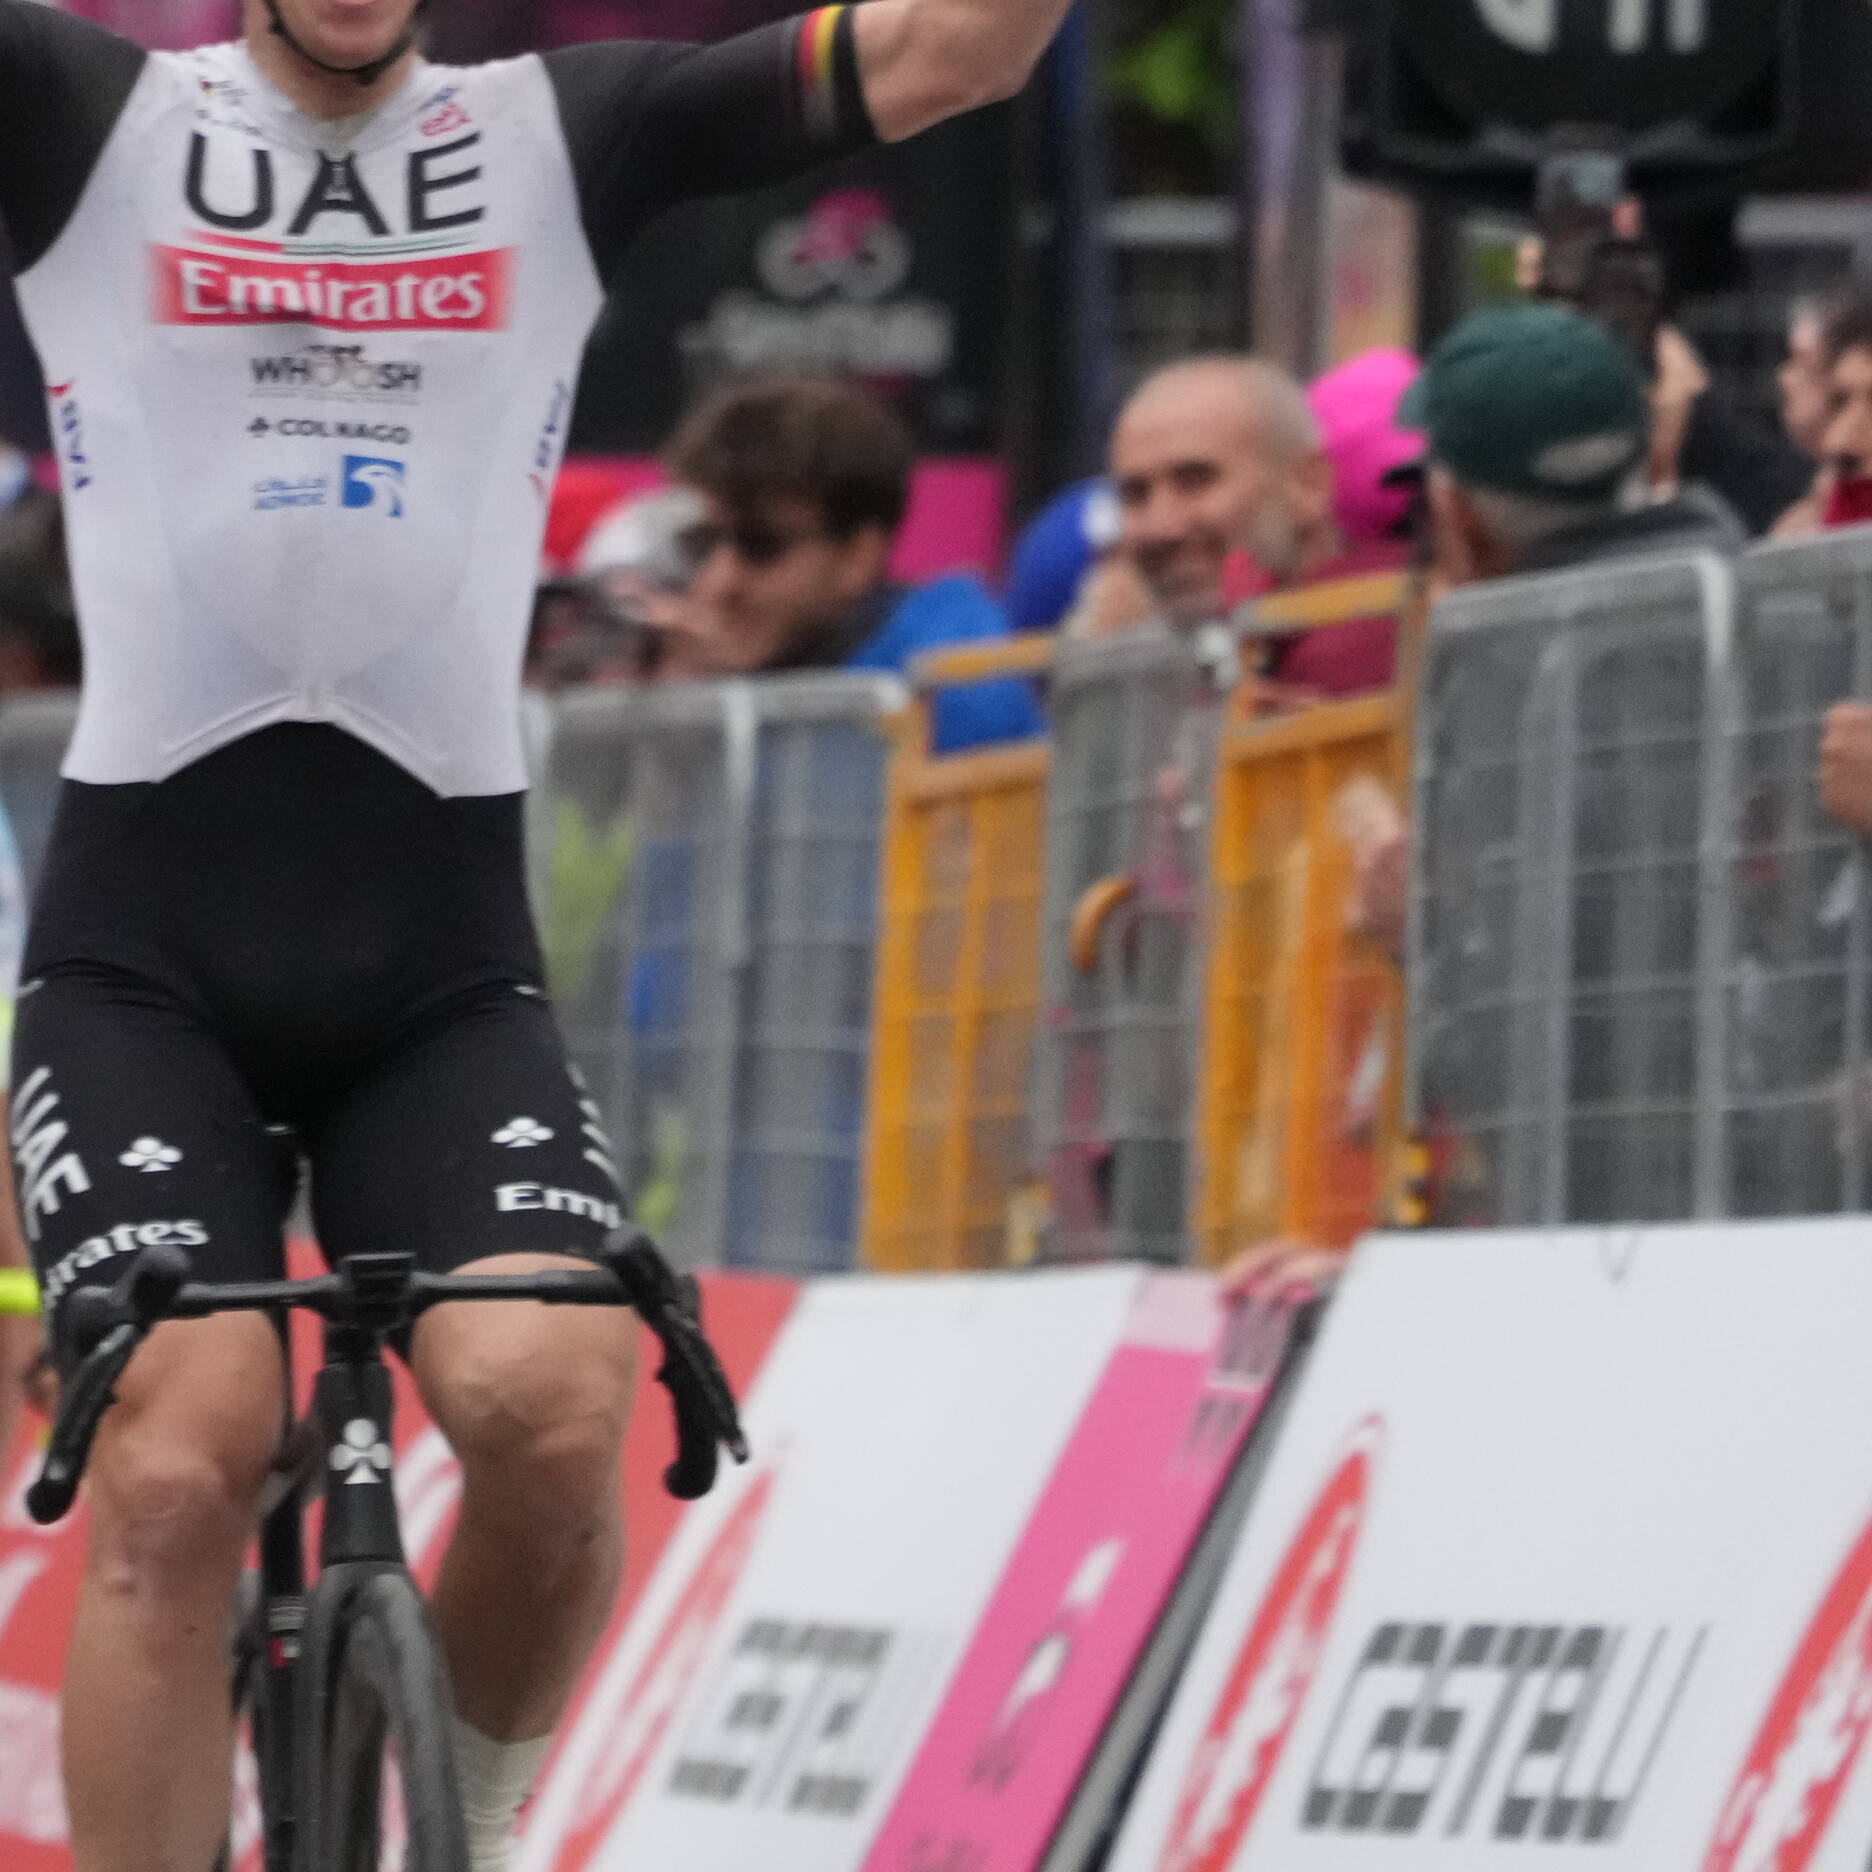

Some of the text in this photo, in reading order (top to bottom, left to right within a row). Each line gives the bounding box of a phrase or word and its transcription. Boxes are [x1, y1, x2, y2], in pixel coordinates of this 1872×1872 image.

[184, 129, 488, 237] UAE
[180, 258, 487, 322] Emirates
[276, 417, 412, 446] COLNAGO
